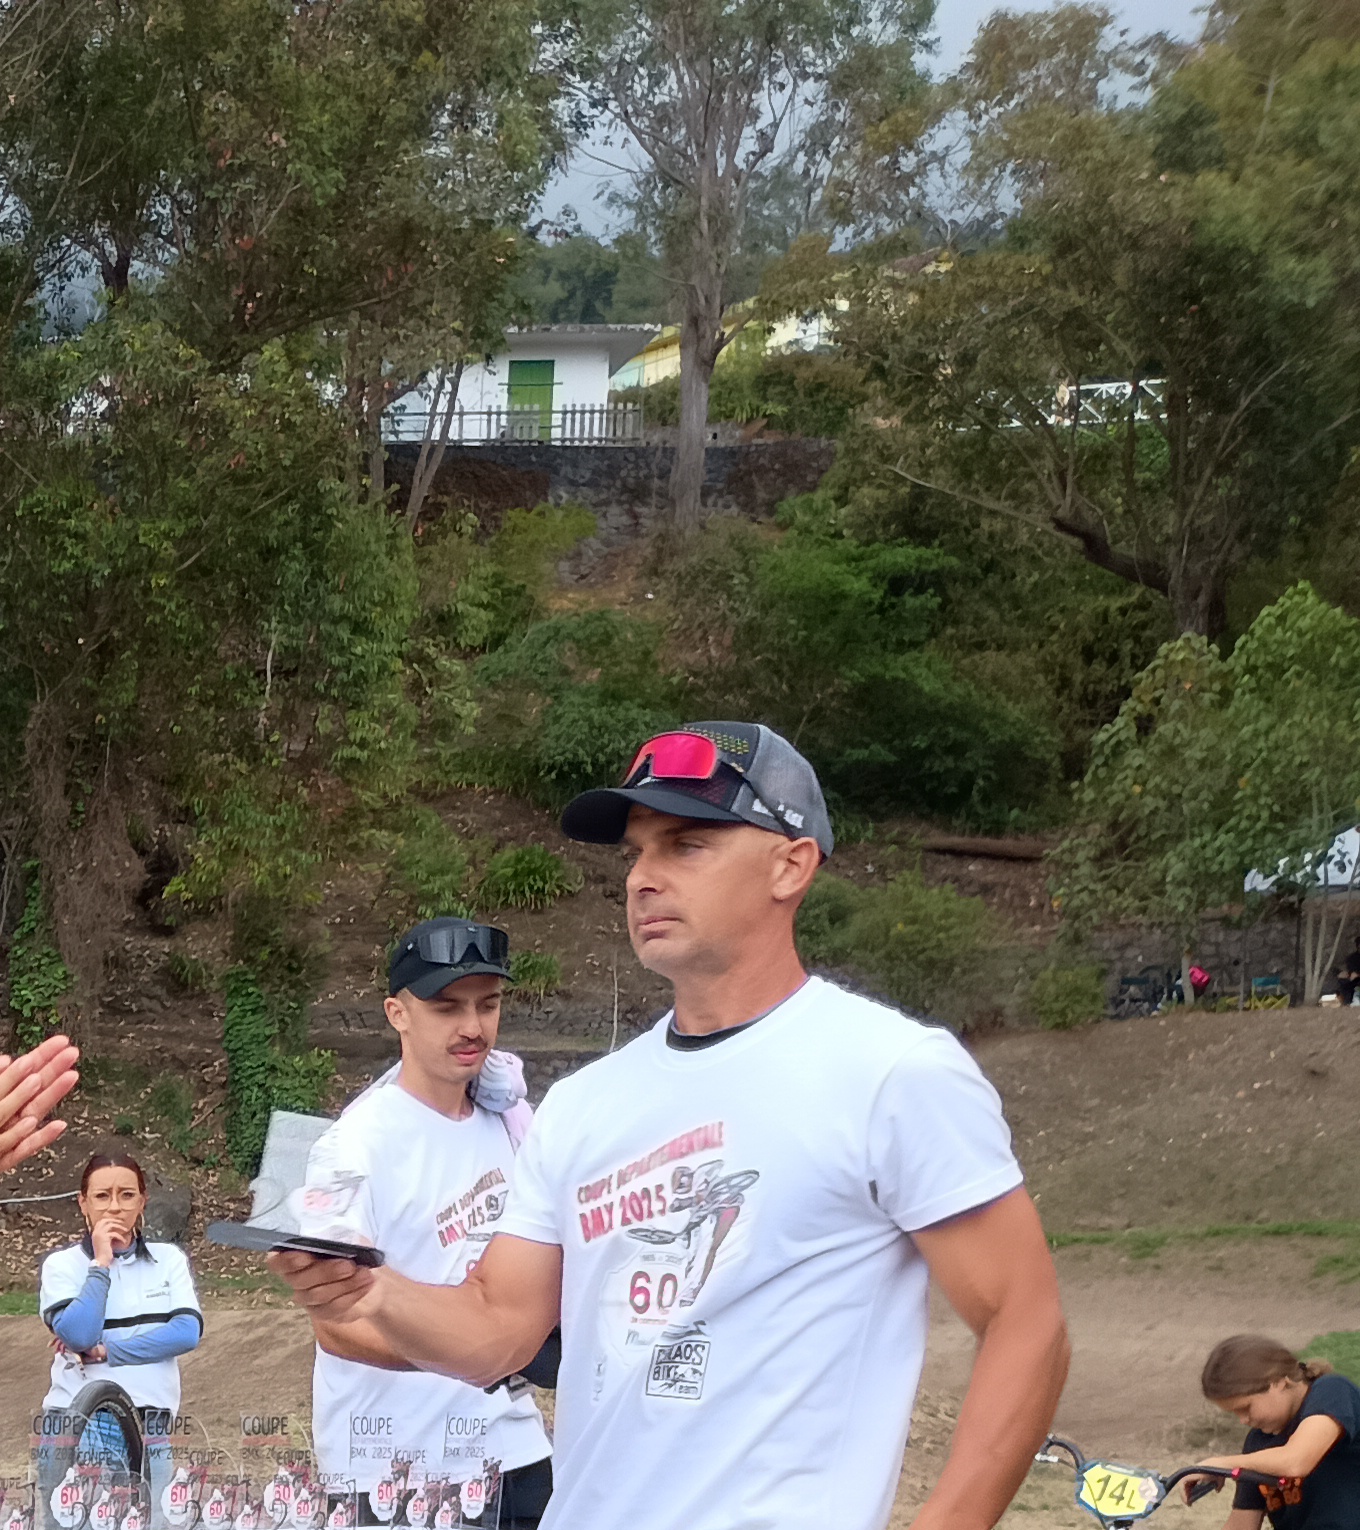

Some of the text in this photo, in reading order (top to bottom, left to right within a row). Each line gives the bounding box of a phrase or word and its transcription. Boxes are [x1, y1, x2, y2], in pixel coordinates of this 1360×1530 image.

[579, 1201, 615, 1243] BMX
[628, 1270, 679, 1315] 60
[33, 1415, 81, 1436] COUPE
[146, 1415, 192, 1436] COUPE
[242, 1415, 289, 1436] COUPE
[352, 1416, 393, 1436] COUPE
[447, 1416, 488, 1436] COUPE
[60, 1486, 79, 1505] 60
[170, 1485, 188, 1503] 60
[377, 1485, 393, 1500] 60
[467, 1485, 483, 1500] 60
[209, 1502, 223, 1516] 60
[296, 1502, 310, 1515] 60
